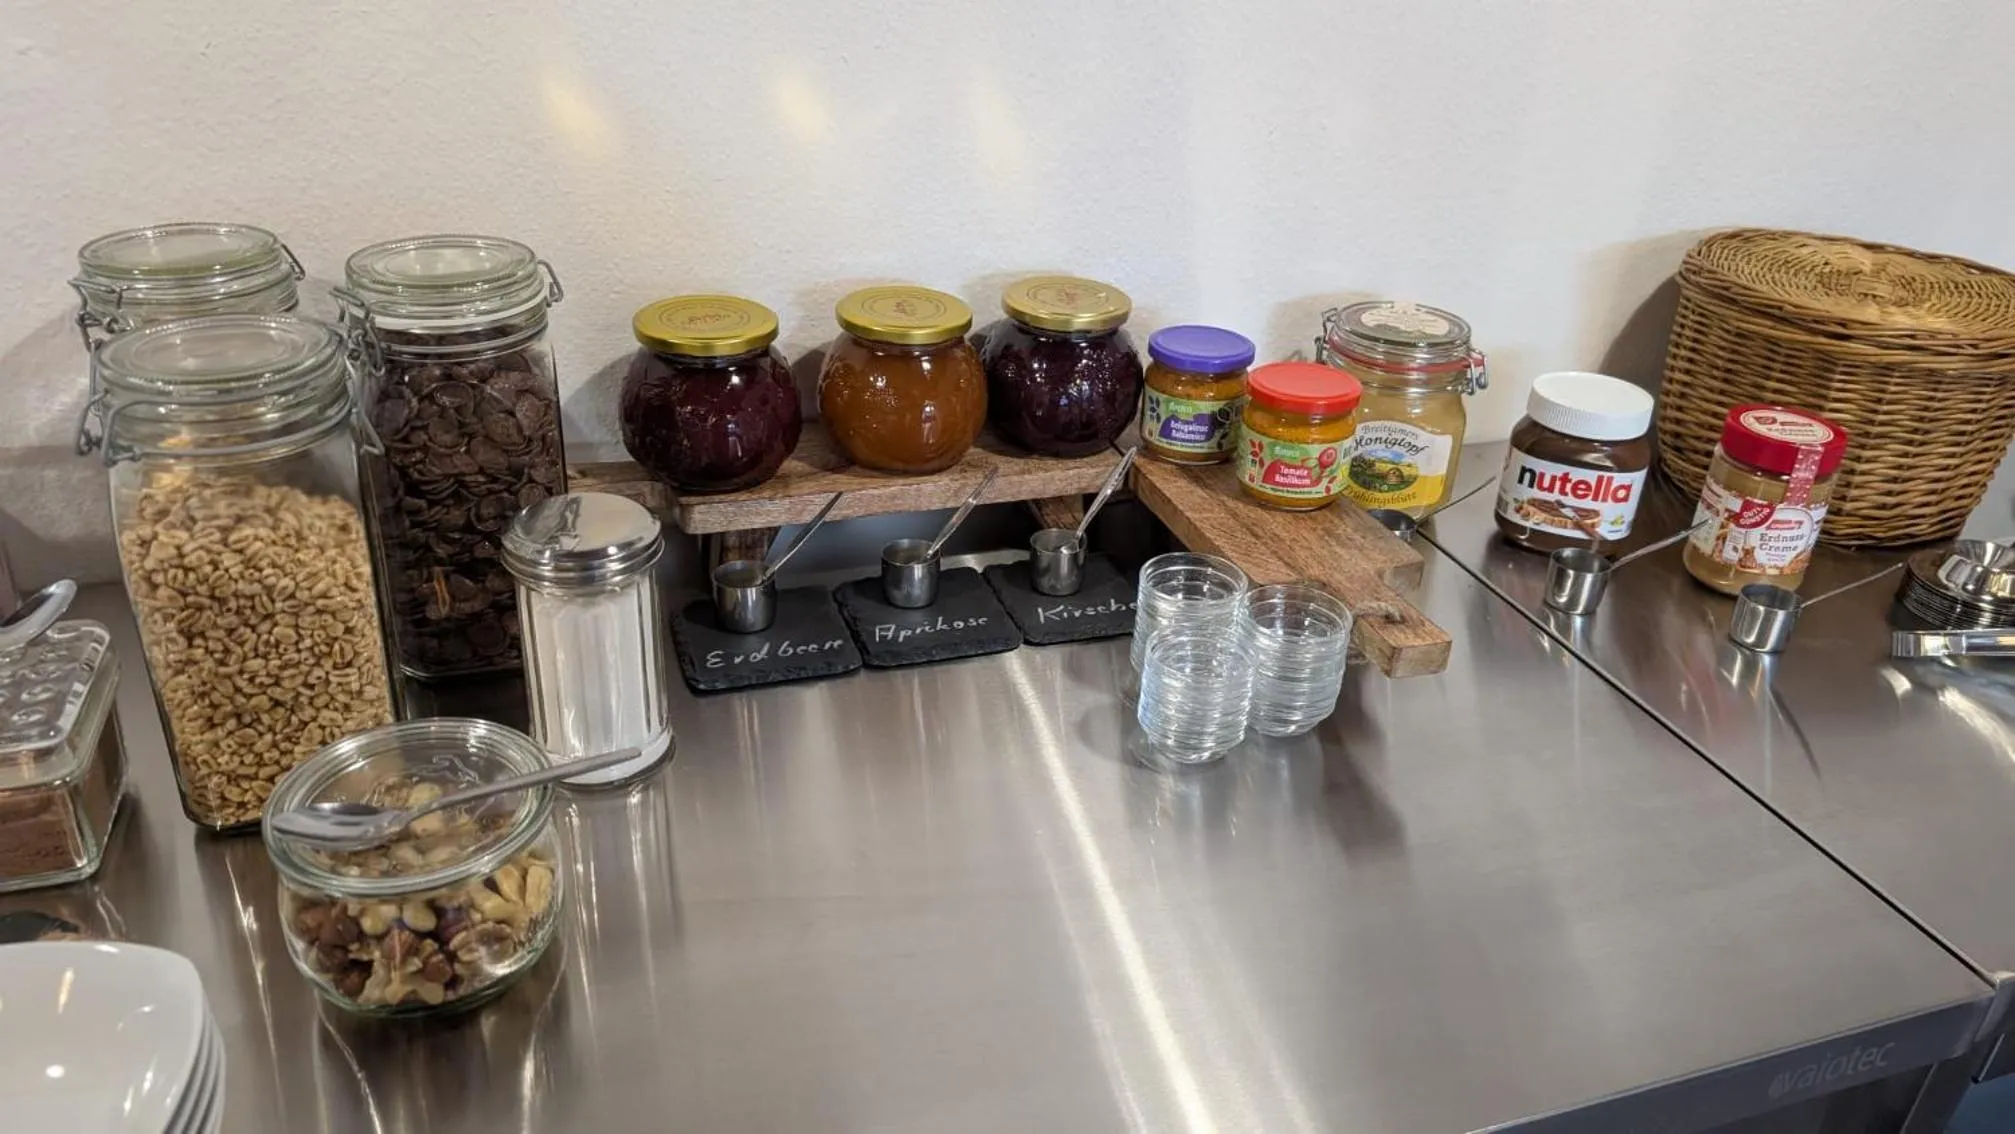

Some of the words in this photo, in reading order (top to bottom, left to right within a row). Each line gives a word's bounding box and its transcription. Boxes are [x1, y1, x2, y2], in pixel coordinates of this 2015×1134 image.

[1280, 465, 1308, 476] Tomate
[1517, 464, 1633, 504] nutella
[1759, 542, 1799, 552] Creme
[875, 616, 988, 642] Aprikose
